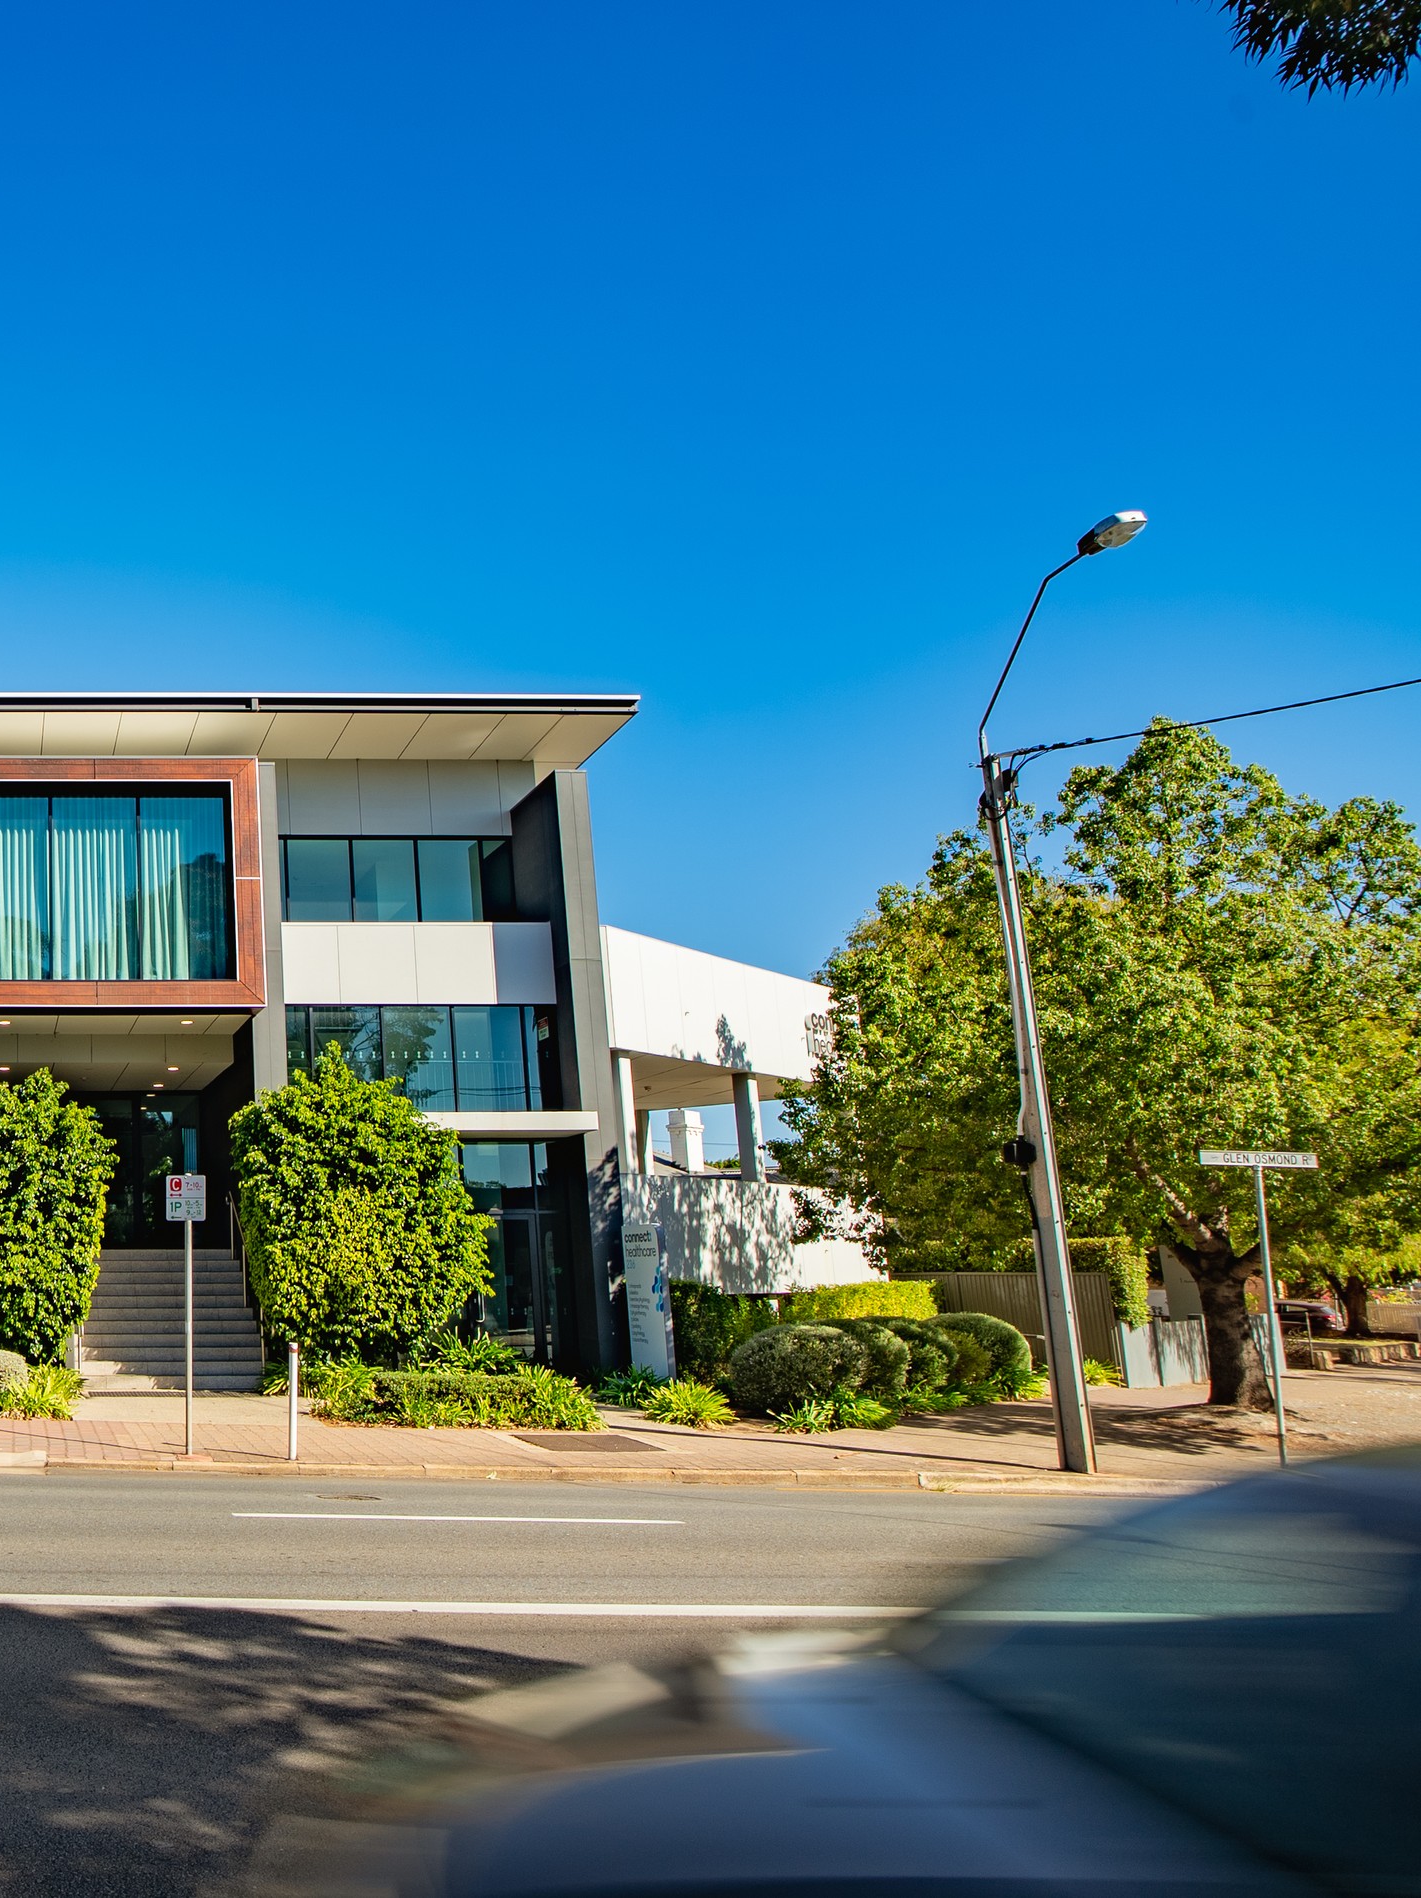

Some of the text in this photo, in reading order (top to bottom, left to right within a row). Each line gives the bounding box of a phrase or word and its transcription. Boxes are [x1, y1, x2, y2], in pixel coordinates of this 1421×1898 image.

[1223, 1153, 1249, 1163] GLEN
[1254, 1154, 1297, 1165] OSMOND
[172, 1179, 180, 1191] C
[170, 1201, 182, 1212] 1P
[625, 1244, 657, 1258] healthcare
